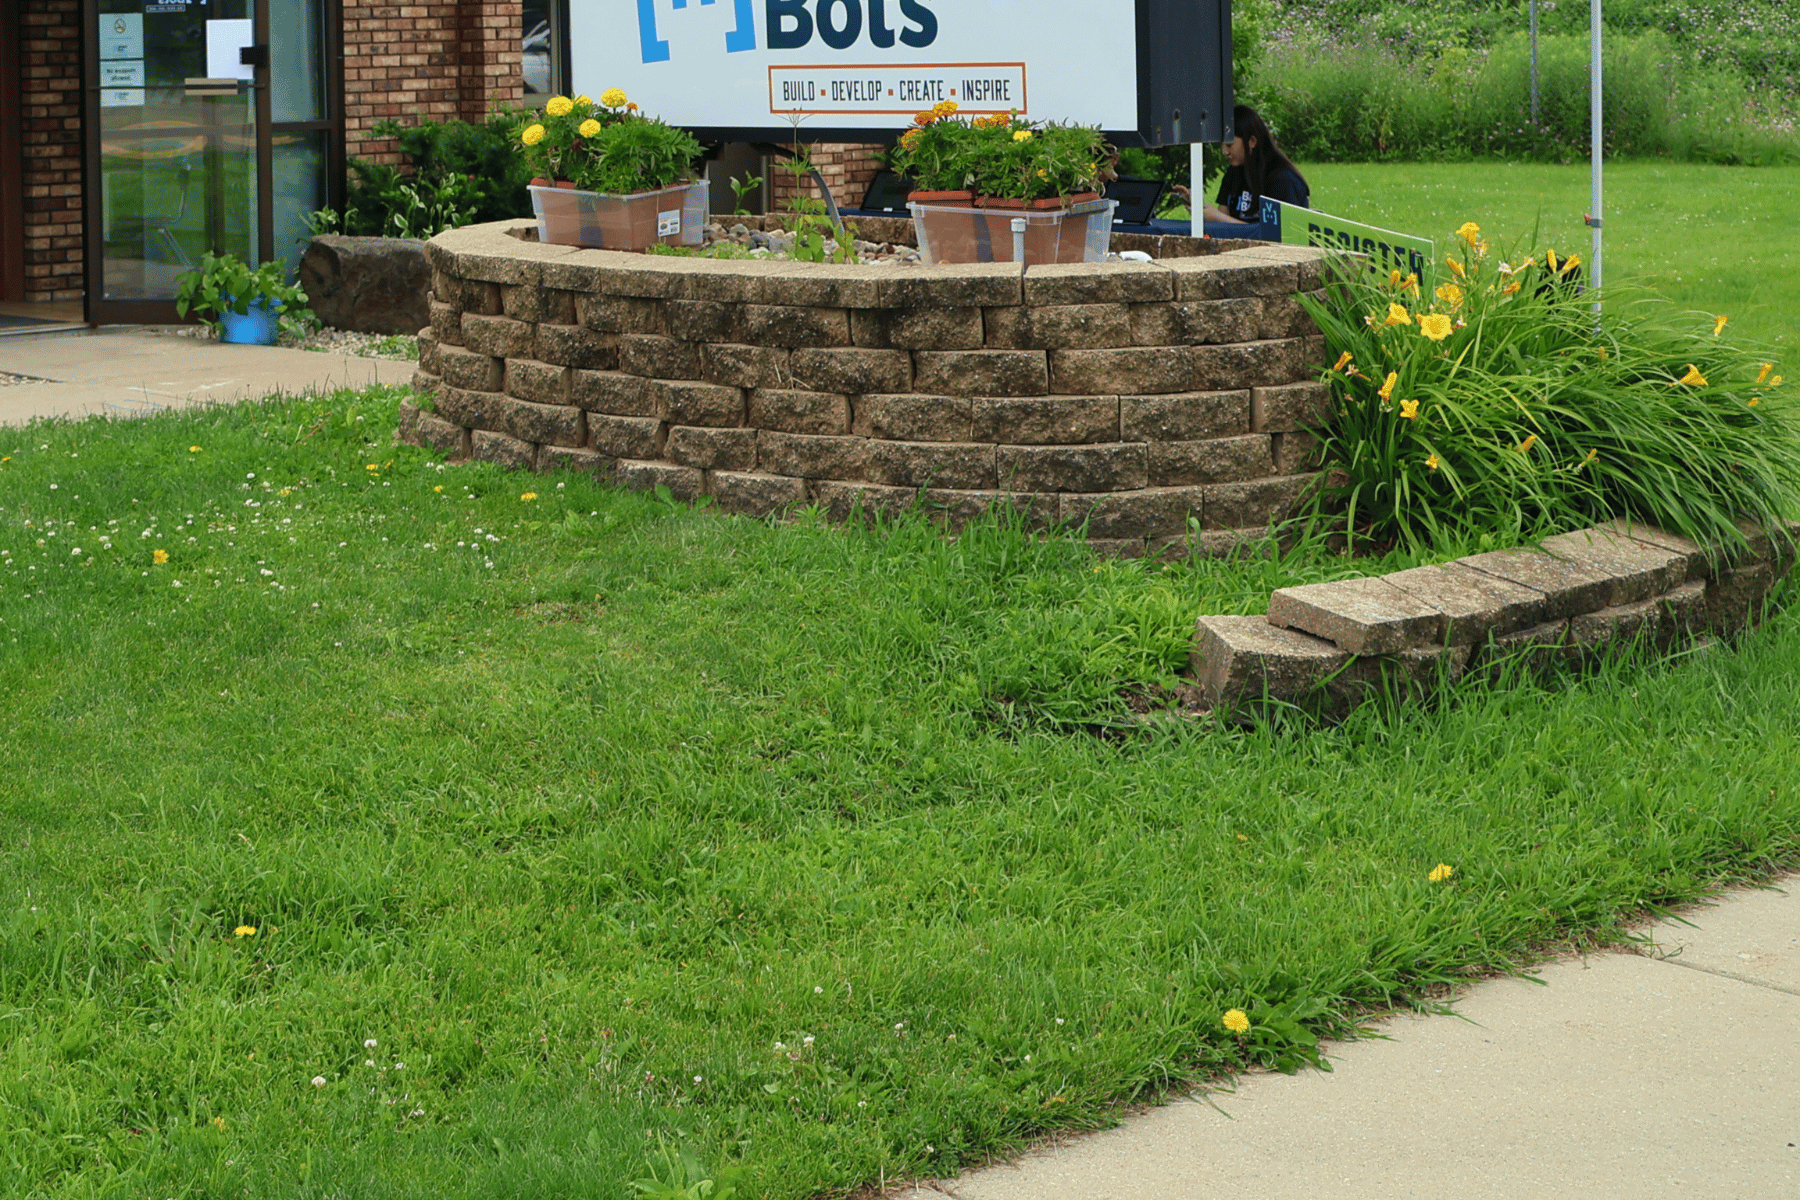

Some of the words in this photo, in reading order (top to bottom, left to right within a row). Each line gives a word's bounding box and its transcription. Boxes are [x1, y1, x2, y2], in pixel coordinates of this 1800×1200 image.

[783, 80, 815, 101] BUILD
[832, 80, 882, 101] DEVELOP
[899, 79, 945, 101] CREATE
[962, 79, 1011, 101] INSPIRE
